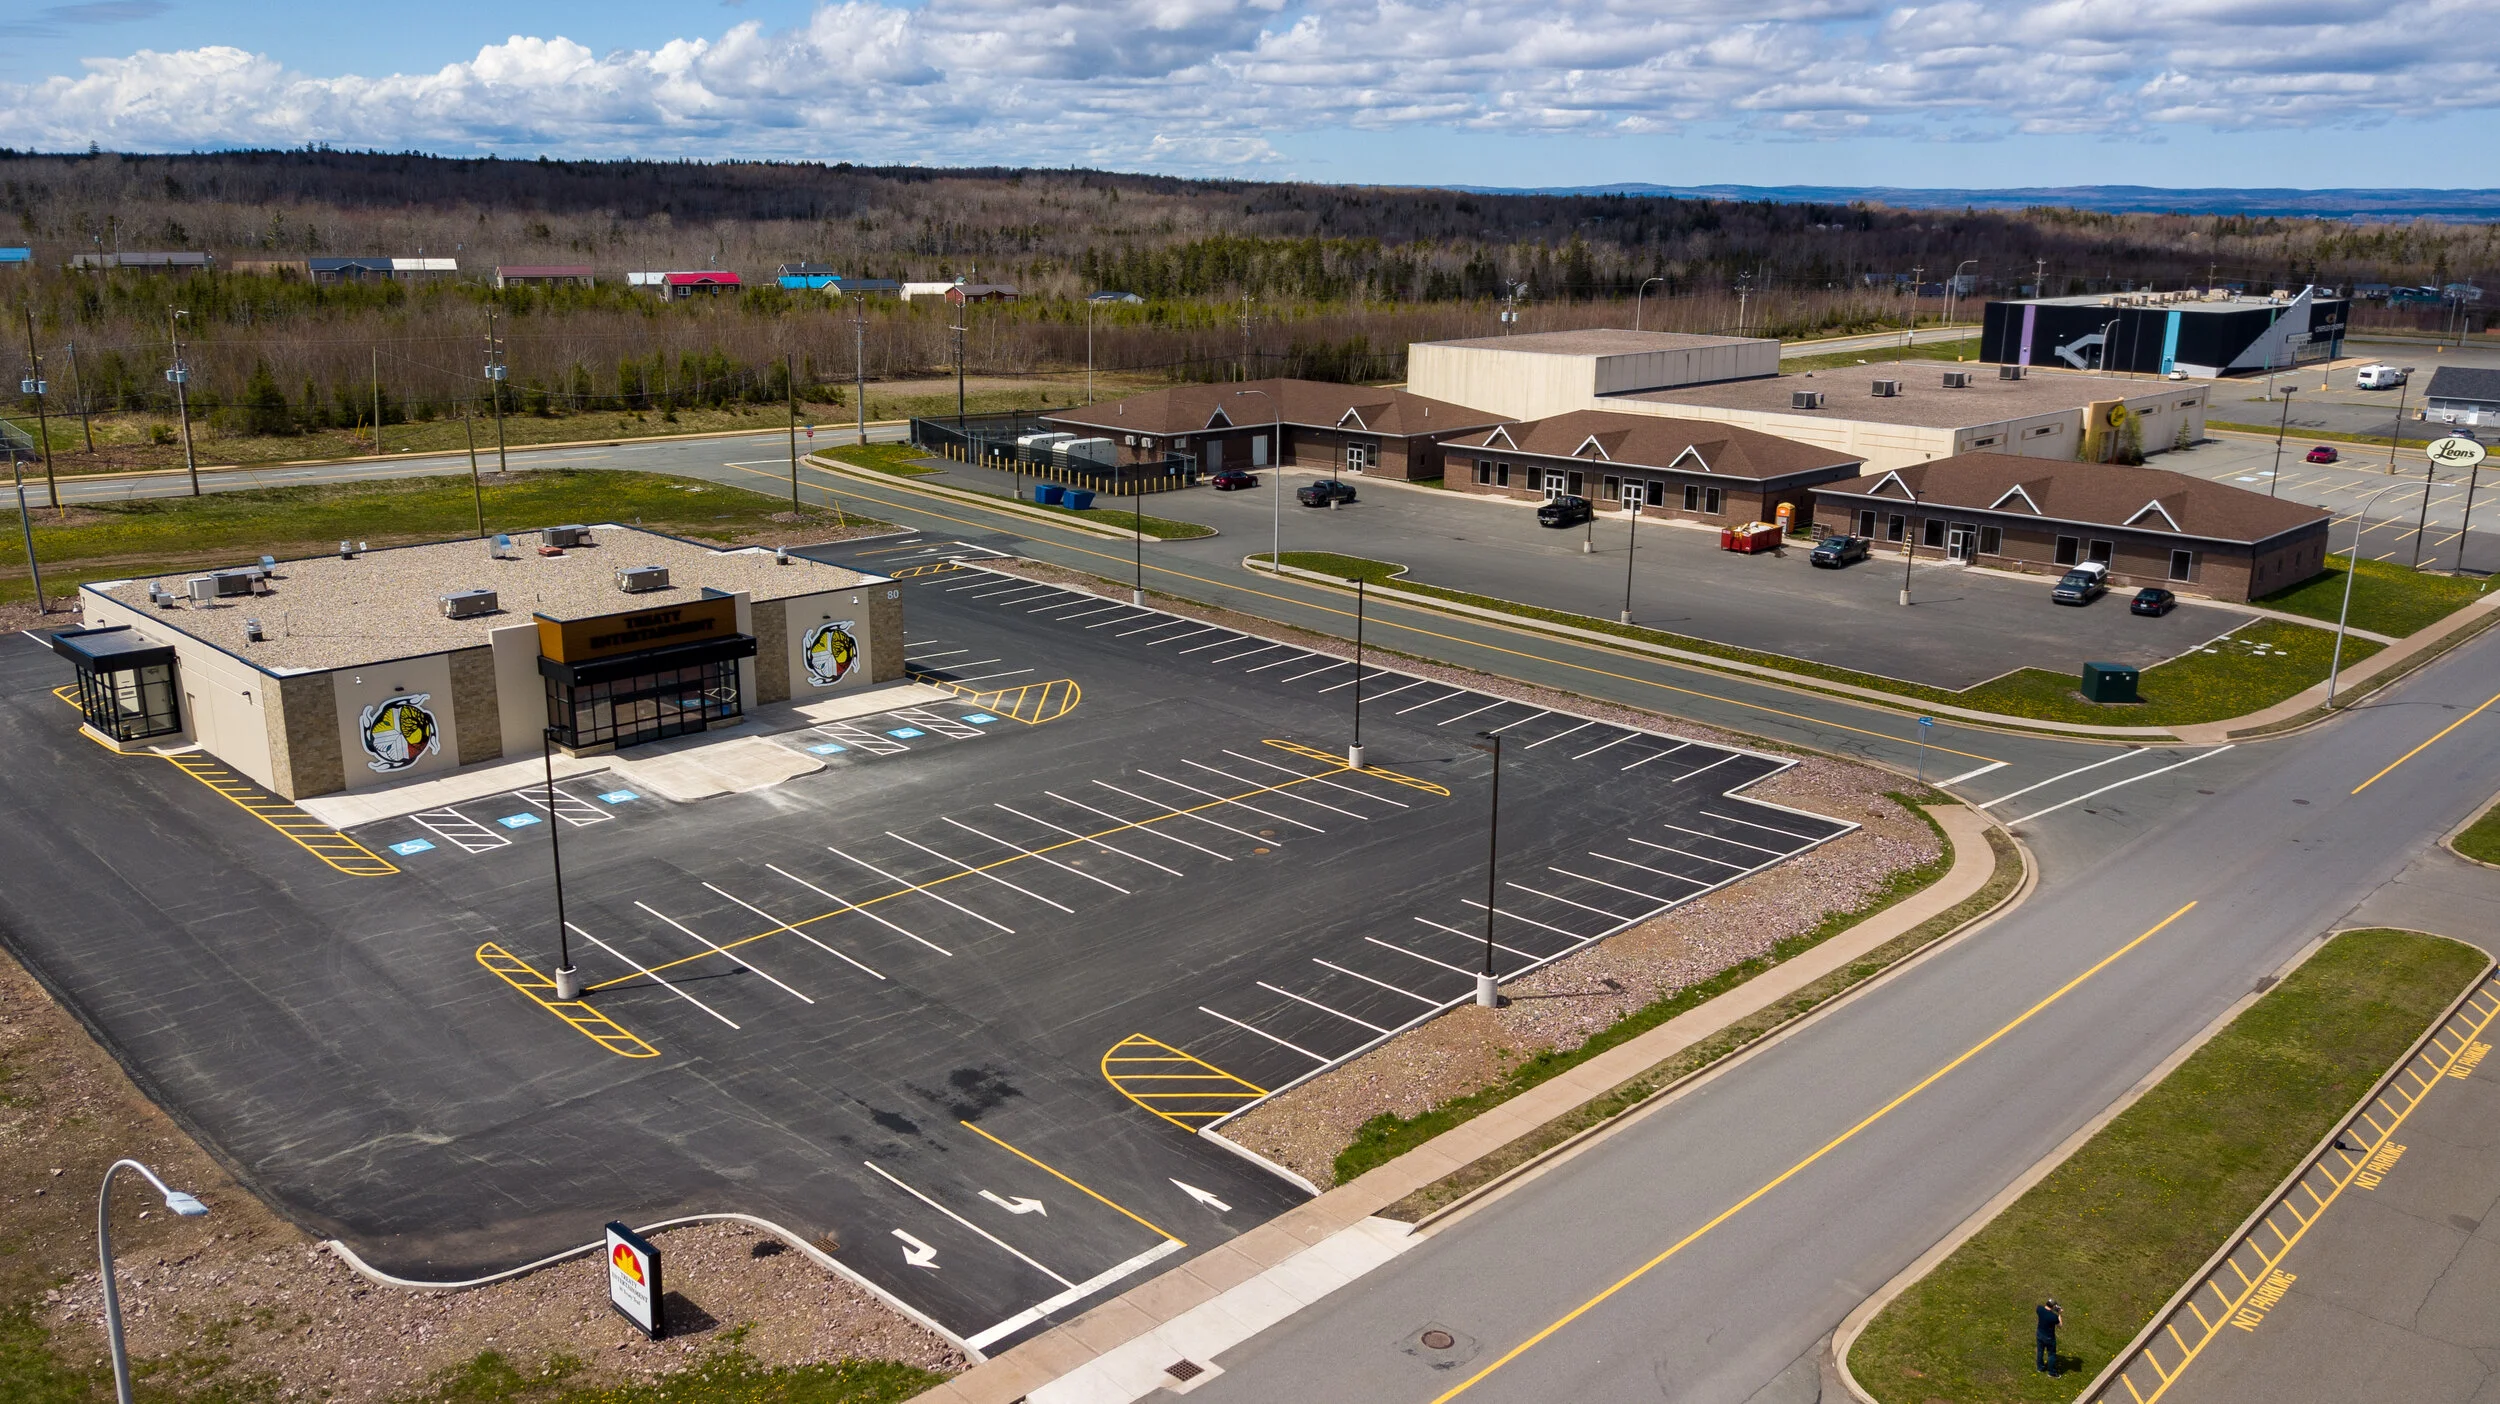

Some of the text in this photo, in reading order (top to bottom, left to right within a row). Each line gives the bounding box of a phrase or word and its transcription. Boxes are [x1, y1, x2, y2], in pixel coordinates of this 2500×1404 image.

[887, 590, 899, 600] 80
[2447, 1041, 2492, 1080] NO PARKING
[2353, 1141, 2408, 1190] NO PARKING
[2230, 1268, 2298, 1332] NO PARKING
